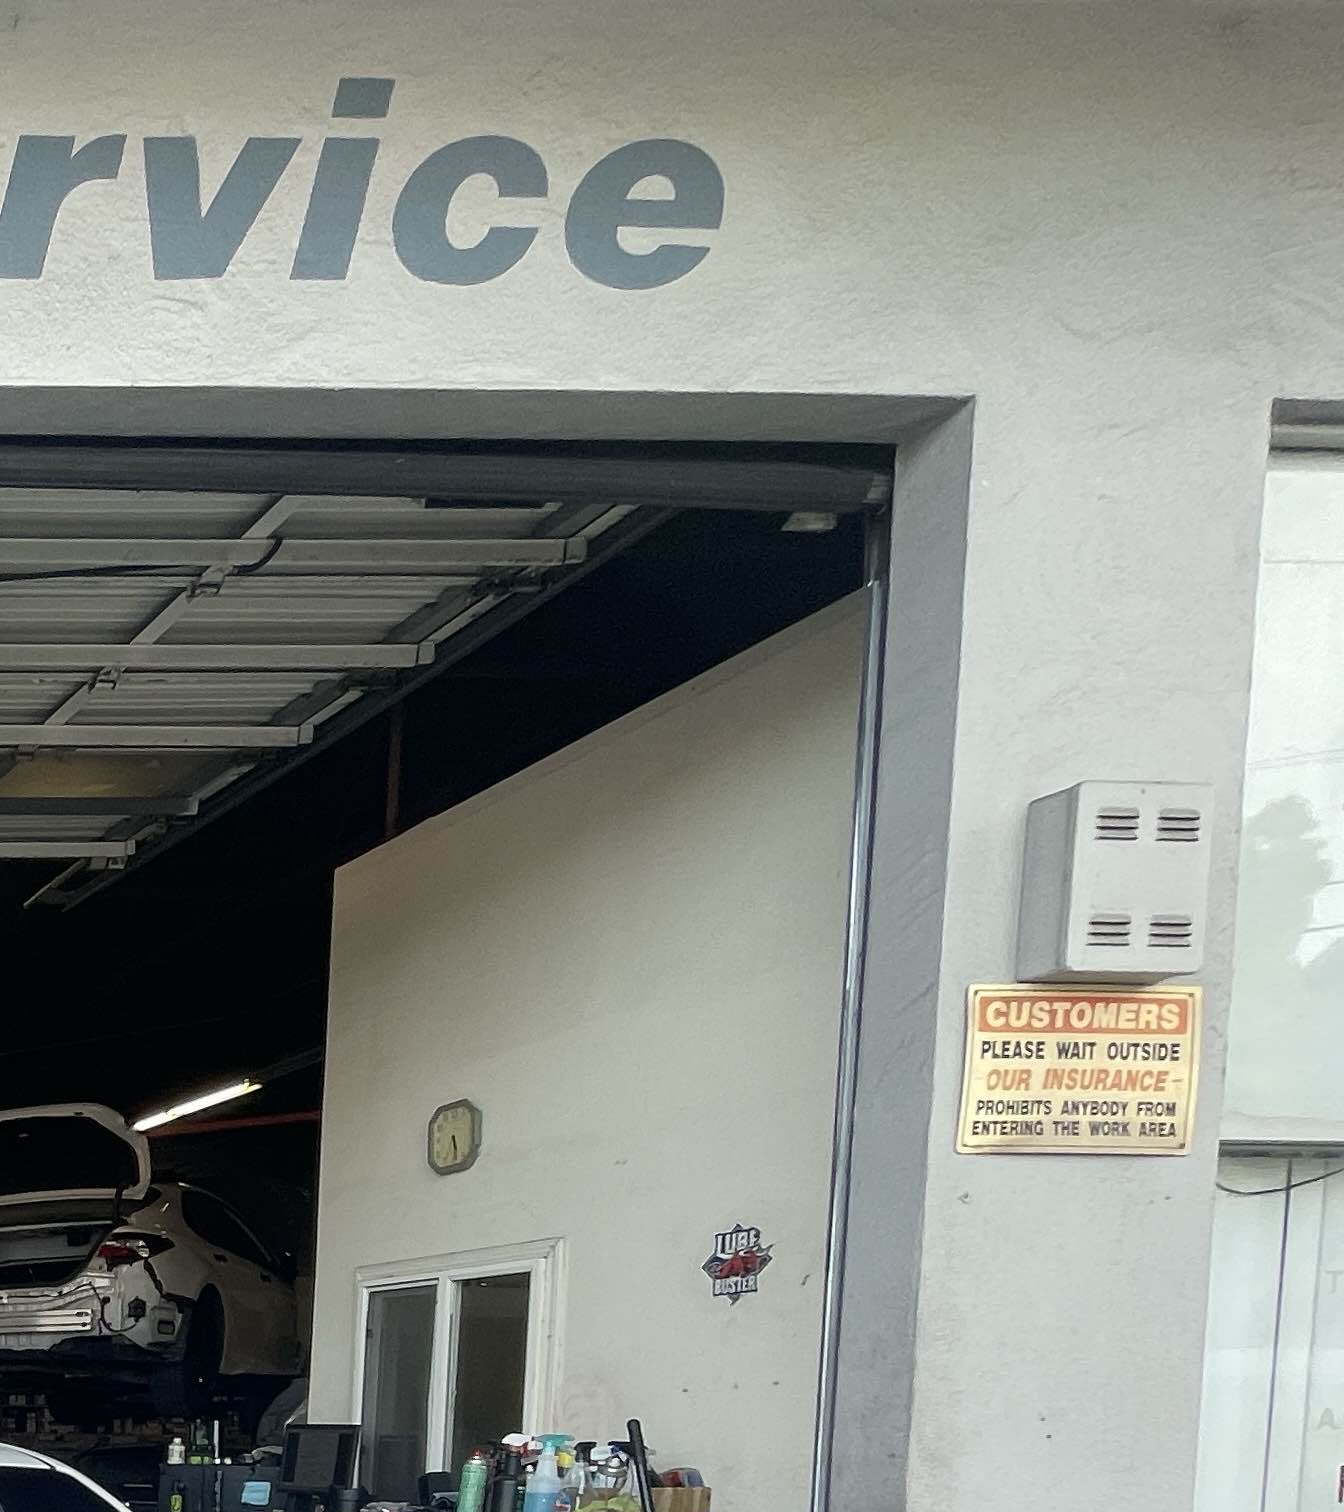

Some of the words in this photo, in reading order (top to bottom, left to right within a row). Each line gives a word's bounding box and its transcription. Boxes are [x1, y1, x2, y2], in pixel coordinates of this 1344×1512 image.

[985, 1001, 1181, 1030] CUSTOMERS
[980, 1040, 1045, 1060] PLEASE
[1056, 1041, 1097, 1060] WAIT
[1107, 1042, 1181, 1061] OUTSIDE
[986, 1068, 1032, 1091] OUR
[1042, 1068, 1169, 1092] INSURANCE
[976, 1100, 1053, 1116] PROHIBITS
[1061, 1100, 1128, 1117] ANYBODY
[1136, 1101, 1177, 1117] FROM
[972, 1120, 1044, 1136] ENTERING
[1053, 1120, 1080, 1136] THE
[1089, 1121, 1130, 1137] WORK
[1139, 1122, 1177, 1138] AREA
